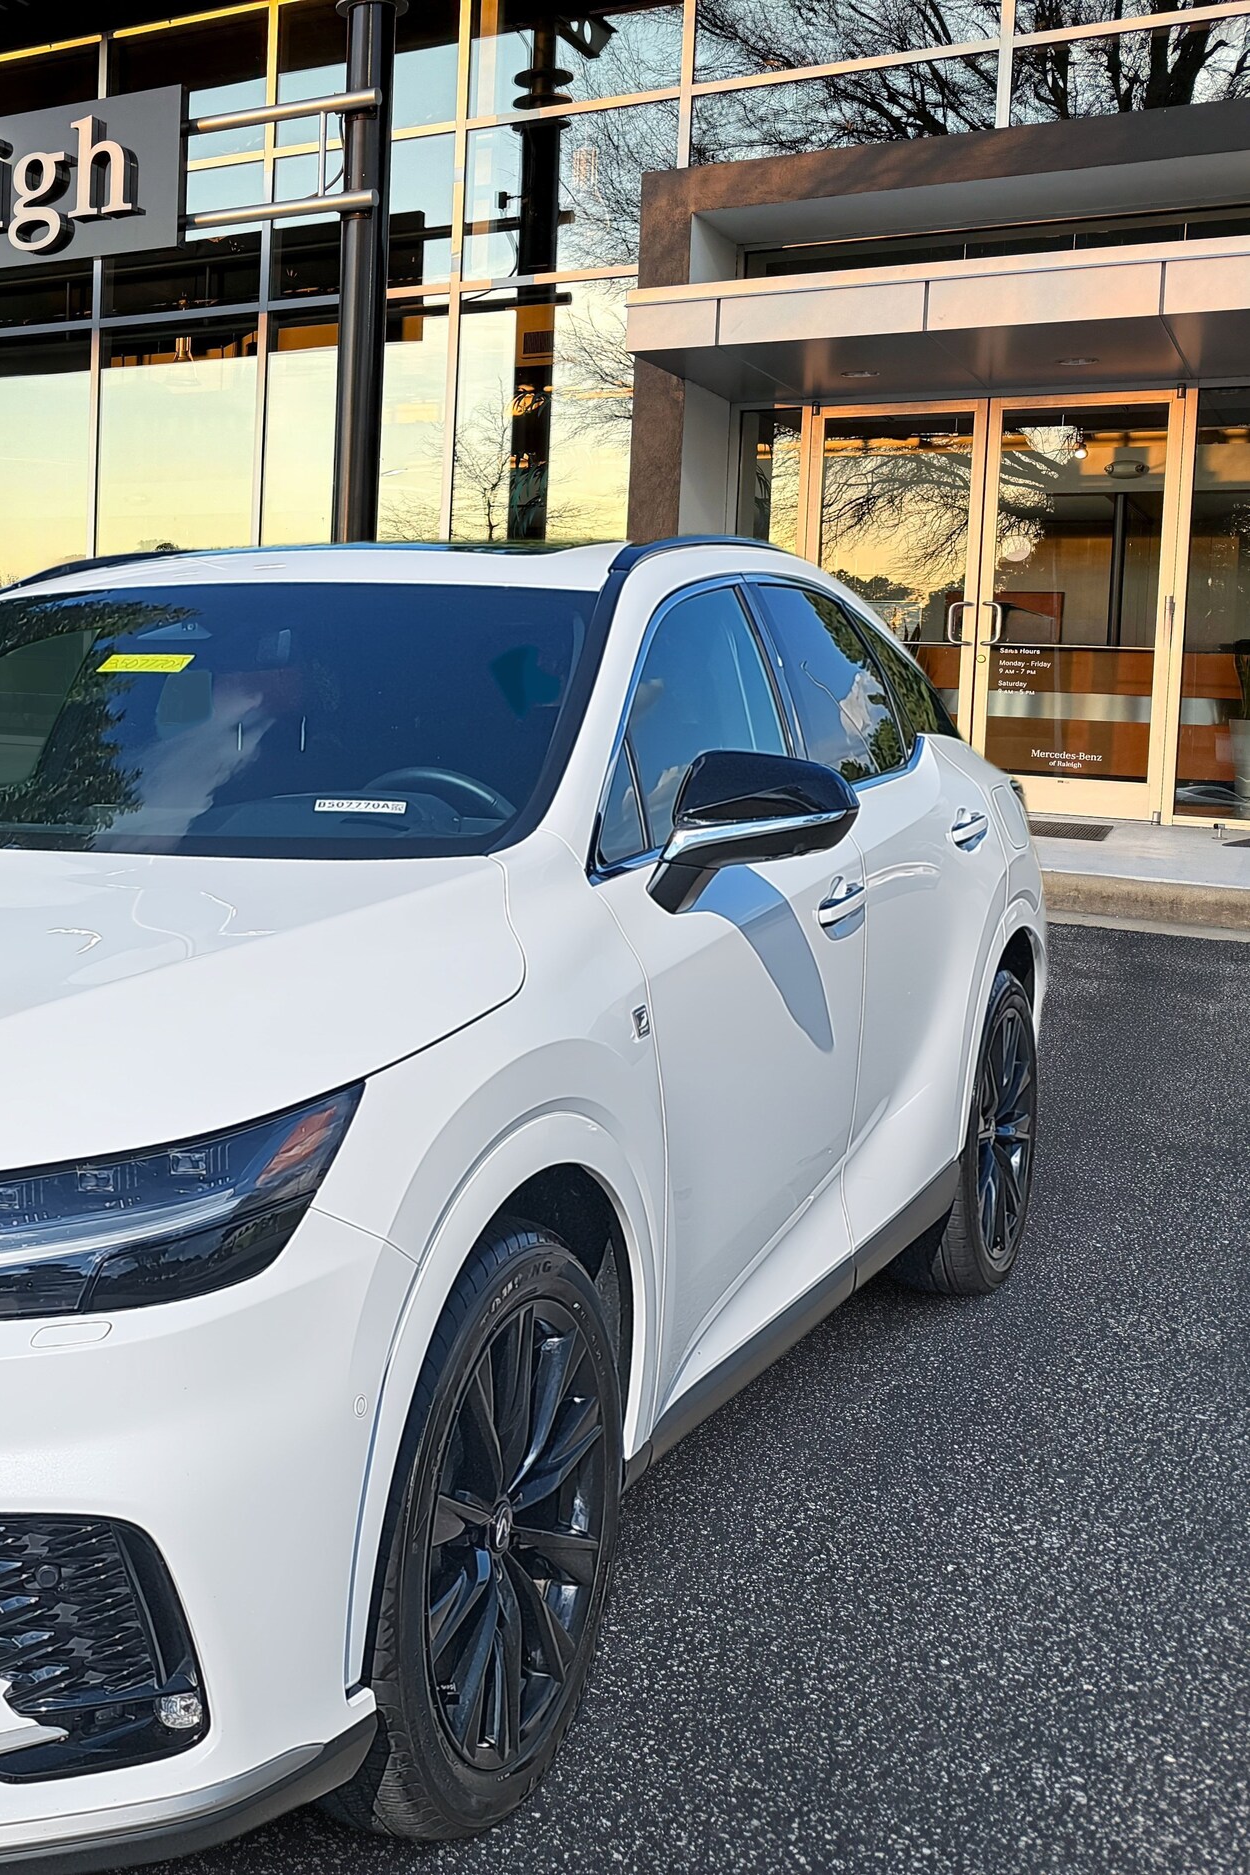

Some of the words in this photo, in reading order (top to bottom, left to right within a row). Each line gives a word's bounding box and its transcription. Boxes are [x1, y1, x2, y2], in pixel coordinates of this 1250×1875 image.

[998, 680, 1027, 688] Saturday
[1031, 749, 1102, 762] Mercedes-Benz
[1057, 761, 1082, 769] Raleigh
